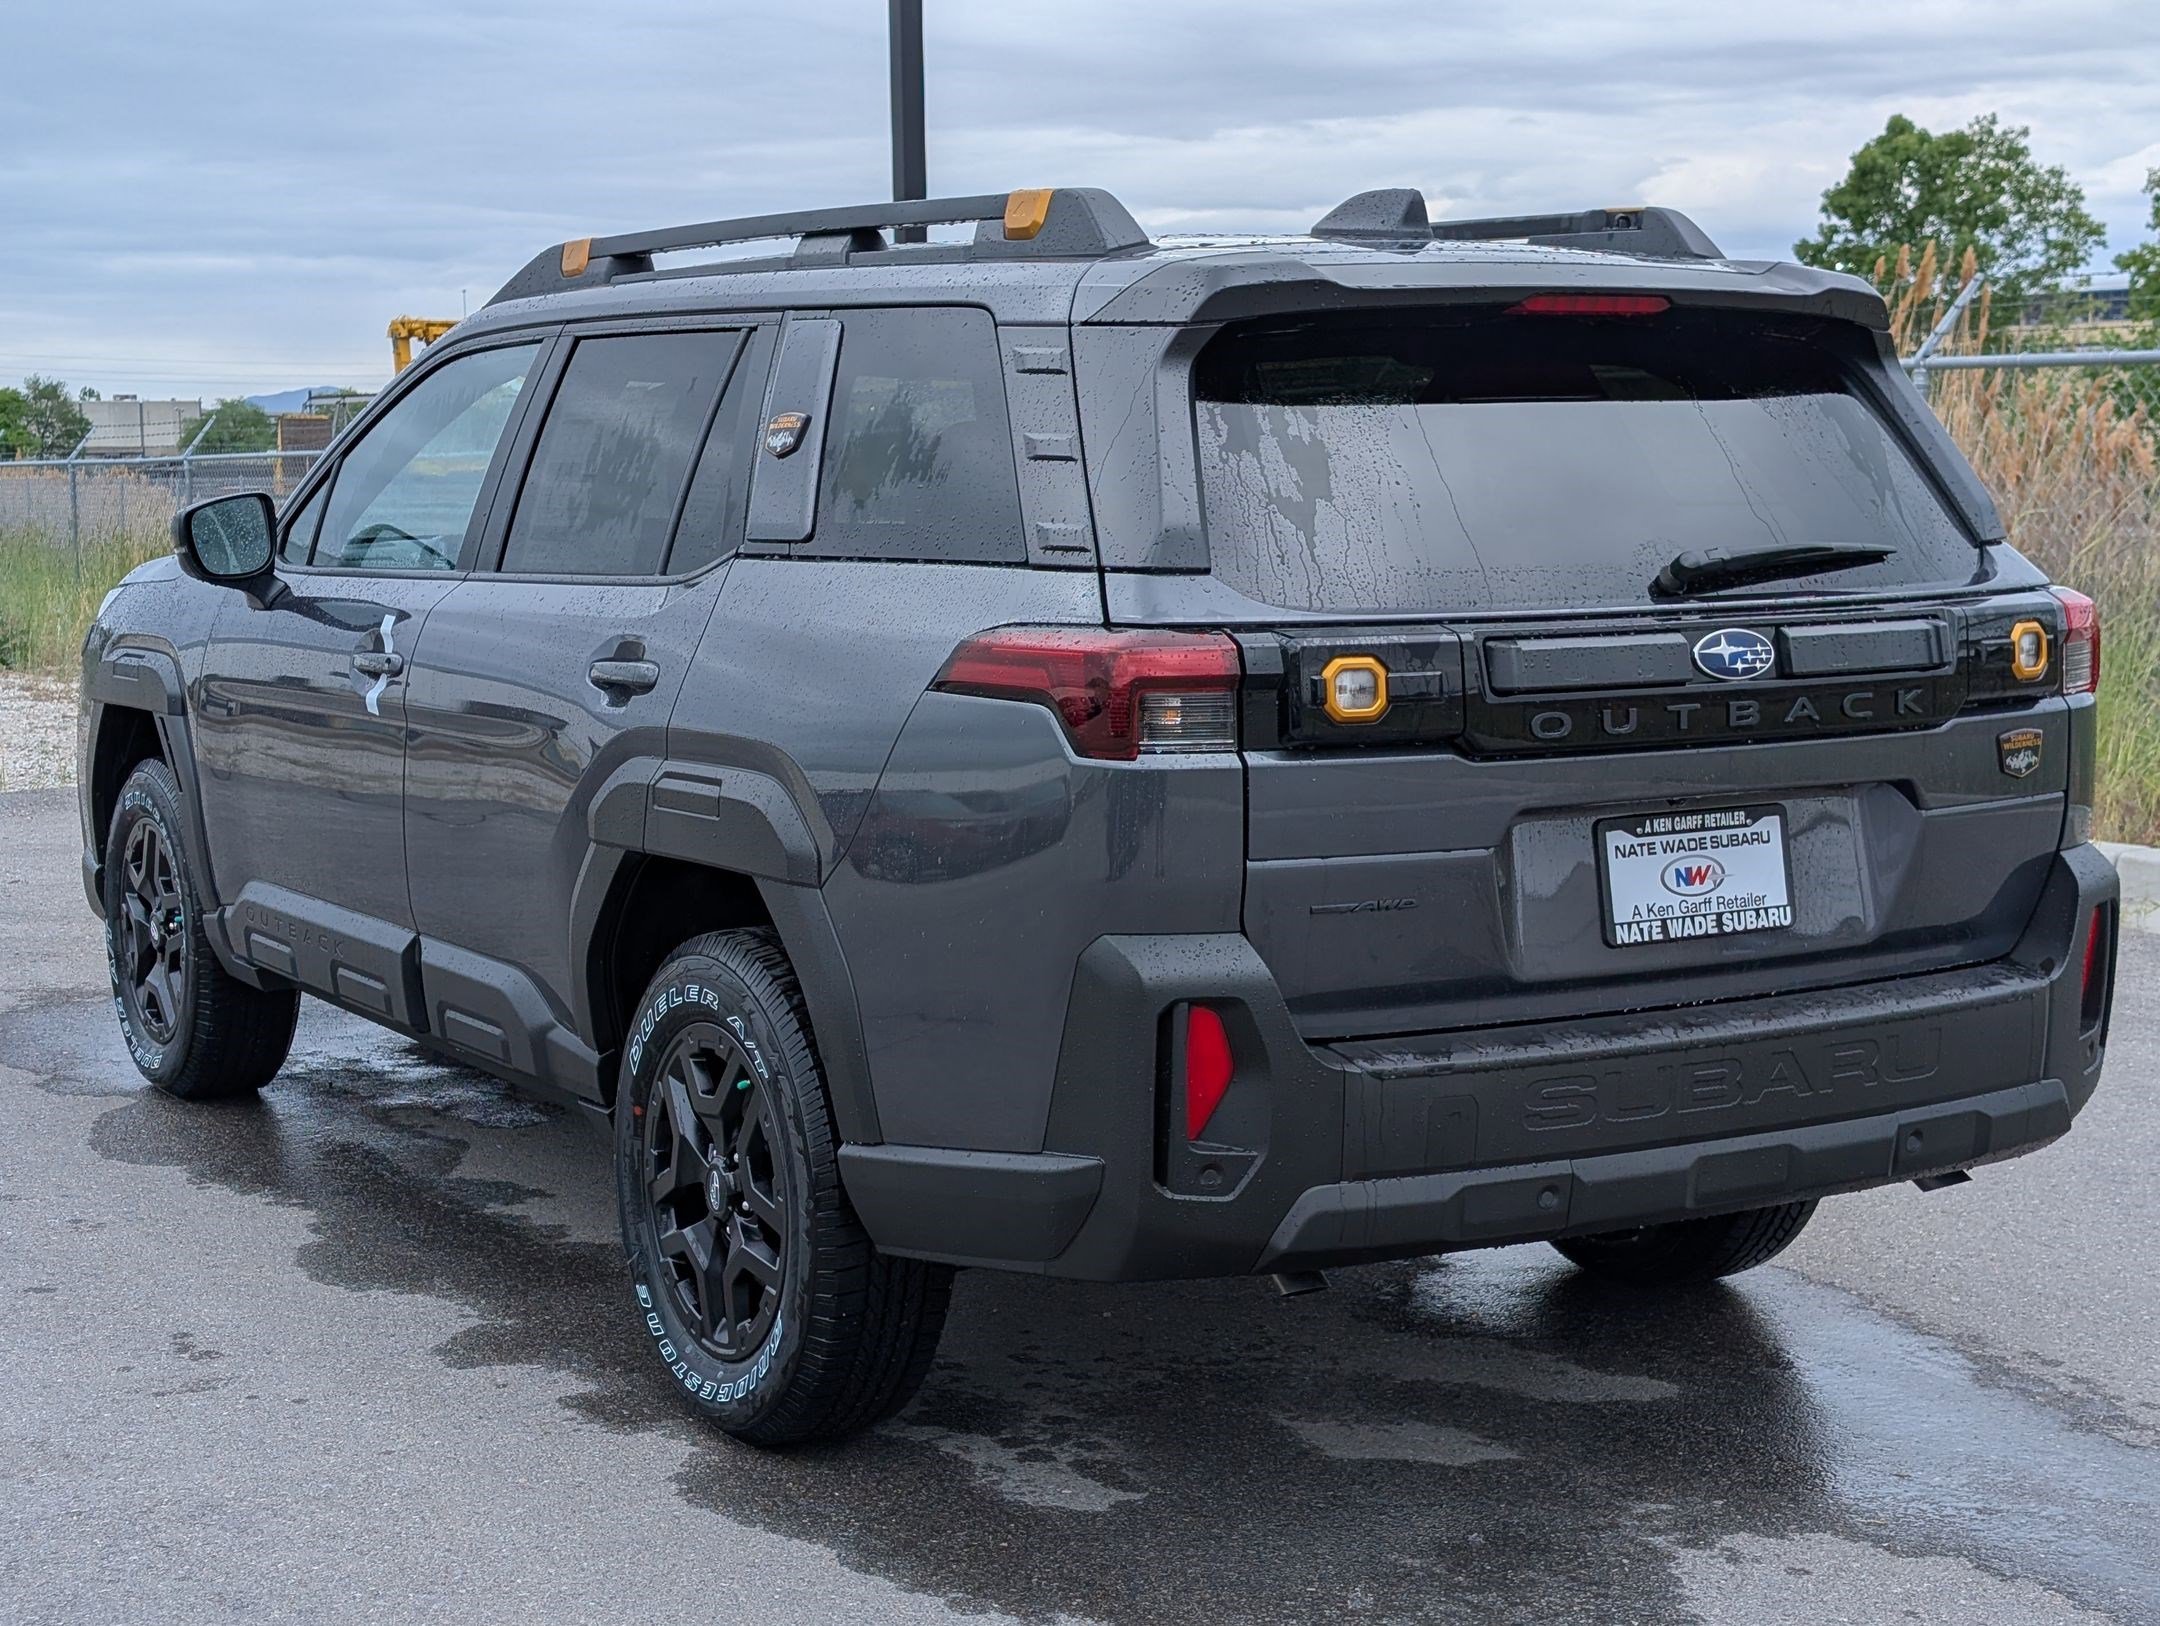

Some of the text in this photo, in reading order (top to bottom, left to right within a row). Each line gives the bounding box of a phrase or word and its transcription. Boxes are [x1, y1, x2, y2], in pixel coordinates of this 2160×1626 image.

[1530, 690, 1925, 739] OUTBACK
[2003, 738, 2041, 750] WILDERNESS
[1644, 811, 1746, 833] A KEN GARFF RETAILER
[1615, 830, 1771, 859] NATE WADE SUBARU
[1674, 864, 1712, 888] NW
[1615, 906, 1792, 945] NATE WADE SUBARU
[1631, 893, 1767, 920] A Ken Garff Retailer
[246, 906, 344, 958] OUTBACK
[115, 996, 163, 1069] DUELER
[629, 984, 769, 1079] DUELER A/T
[1523, 1027, 1943, 1132] SUBARU
[635, 1283, 783, 1402] BRIDGESTONE
